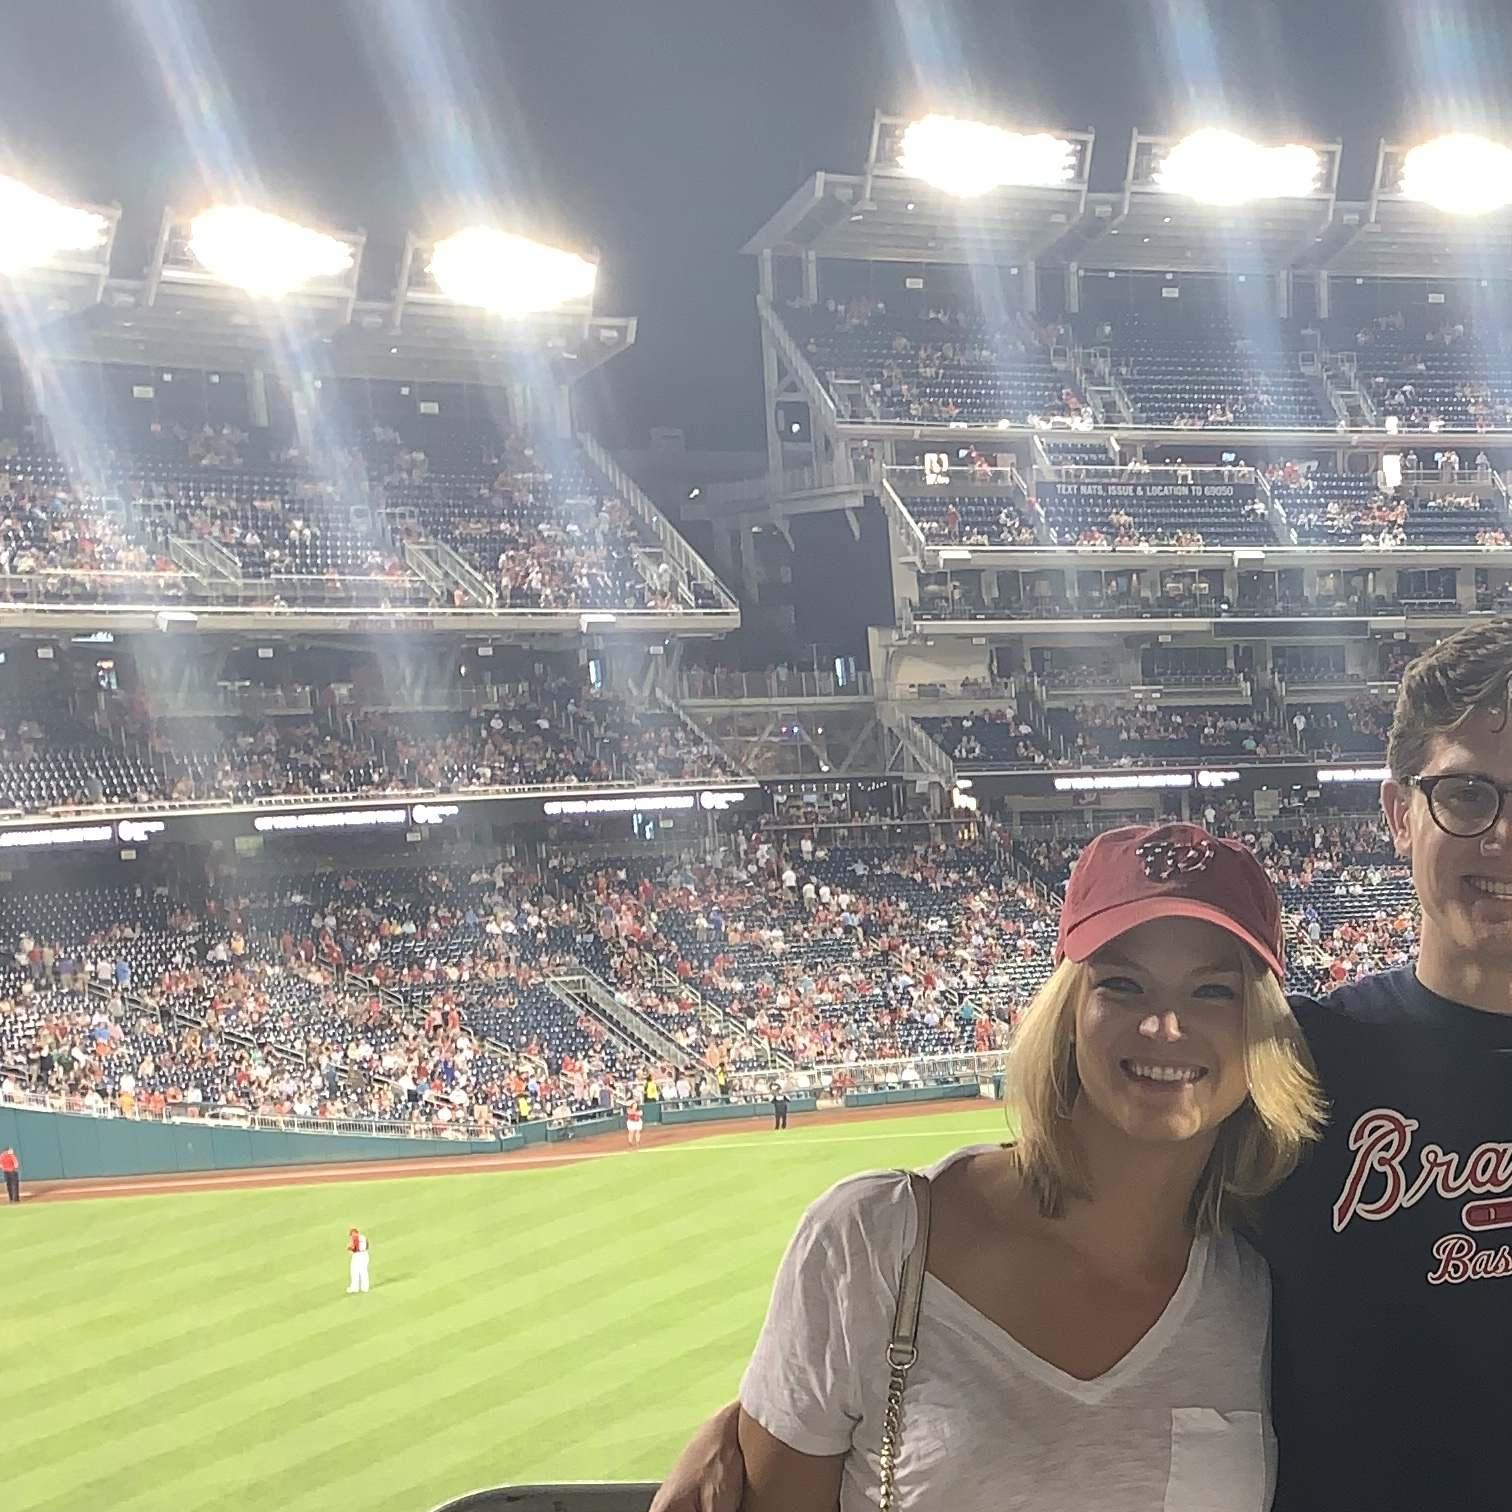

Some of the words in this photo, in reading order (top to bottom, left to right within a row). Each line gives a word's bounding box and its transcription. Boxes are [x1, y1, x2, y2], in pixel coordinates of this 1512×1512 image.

[1056, 484, 1077, 494] TEXT
[1107, 485, 1134, 496] ISSUE
[1136, 486, 1143, 496] &
[1146, 486, 1188, 496] LOCATION
[1191, 486, 1202, 496] TO
